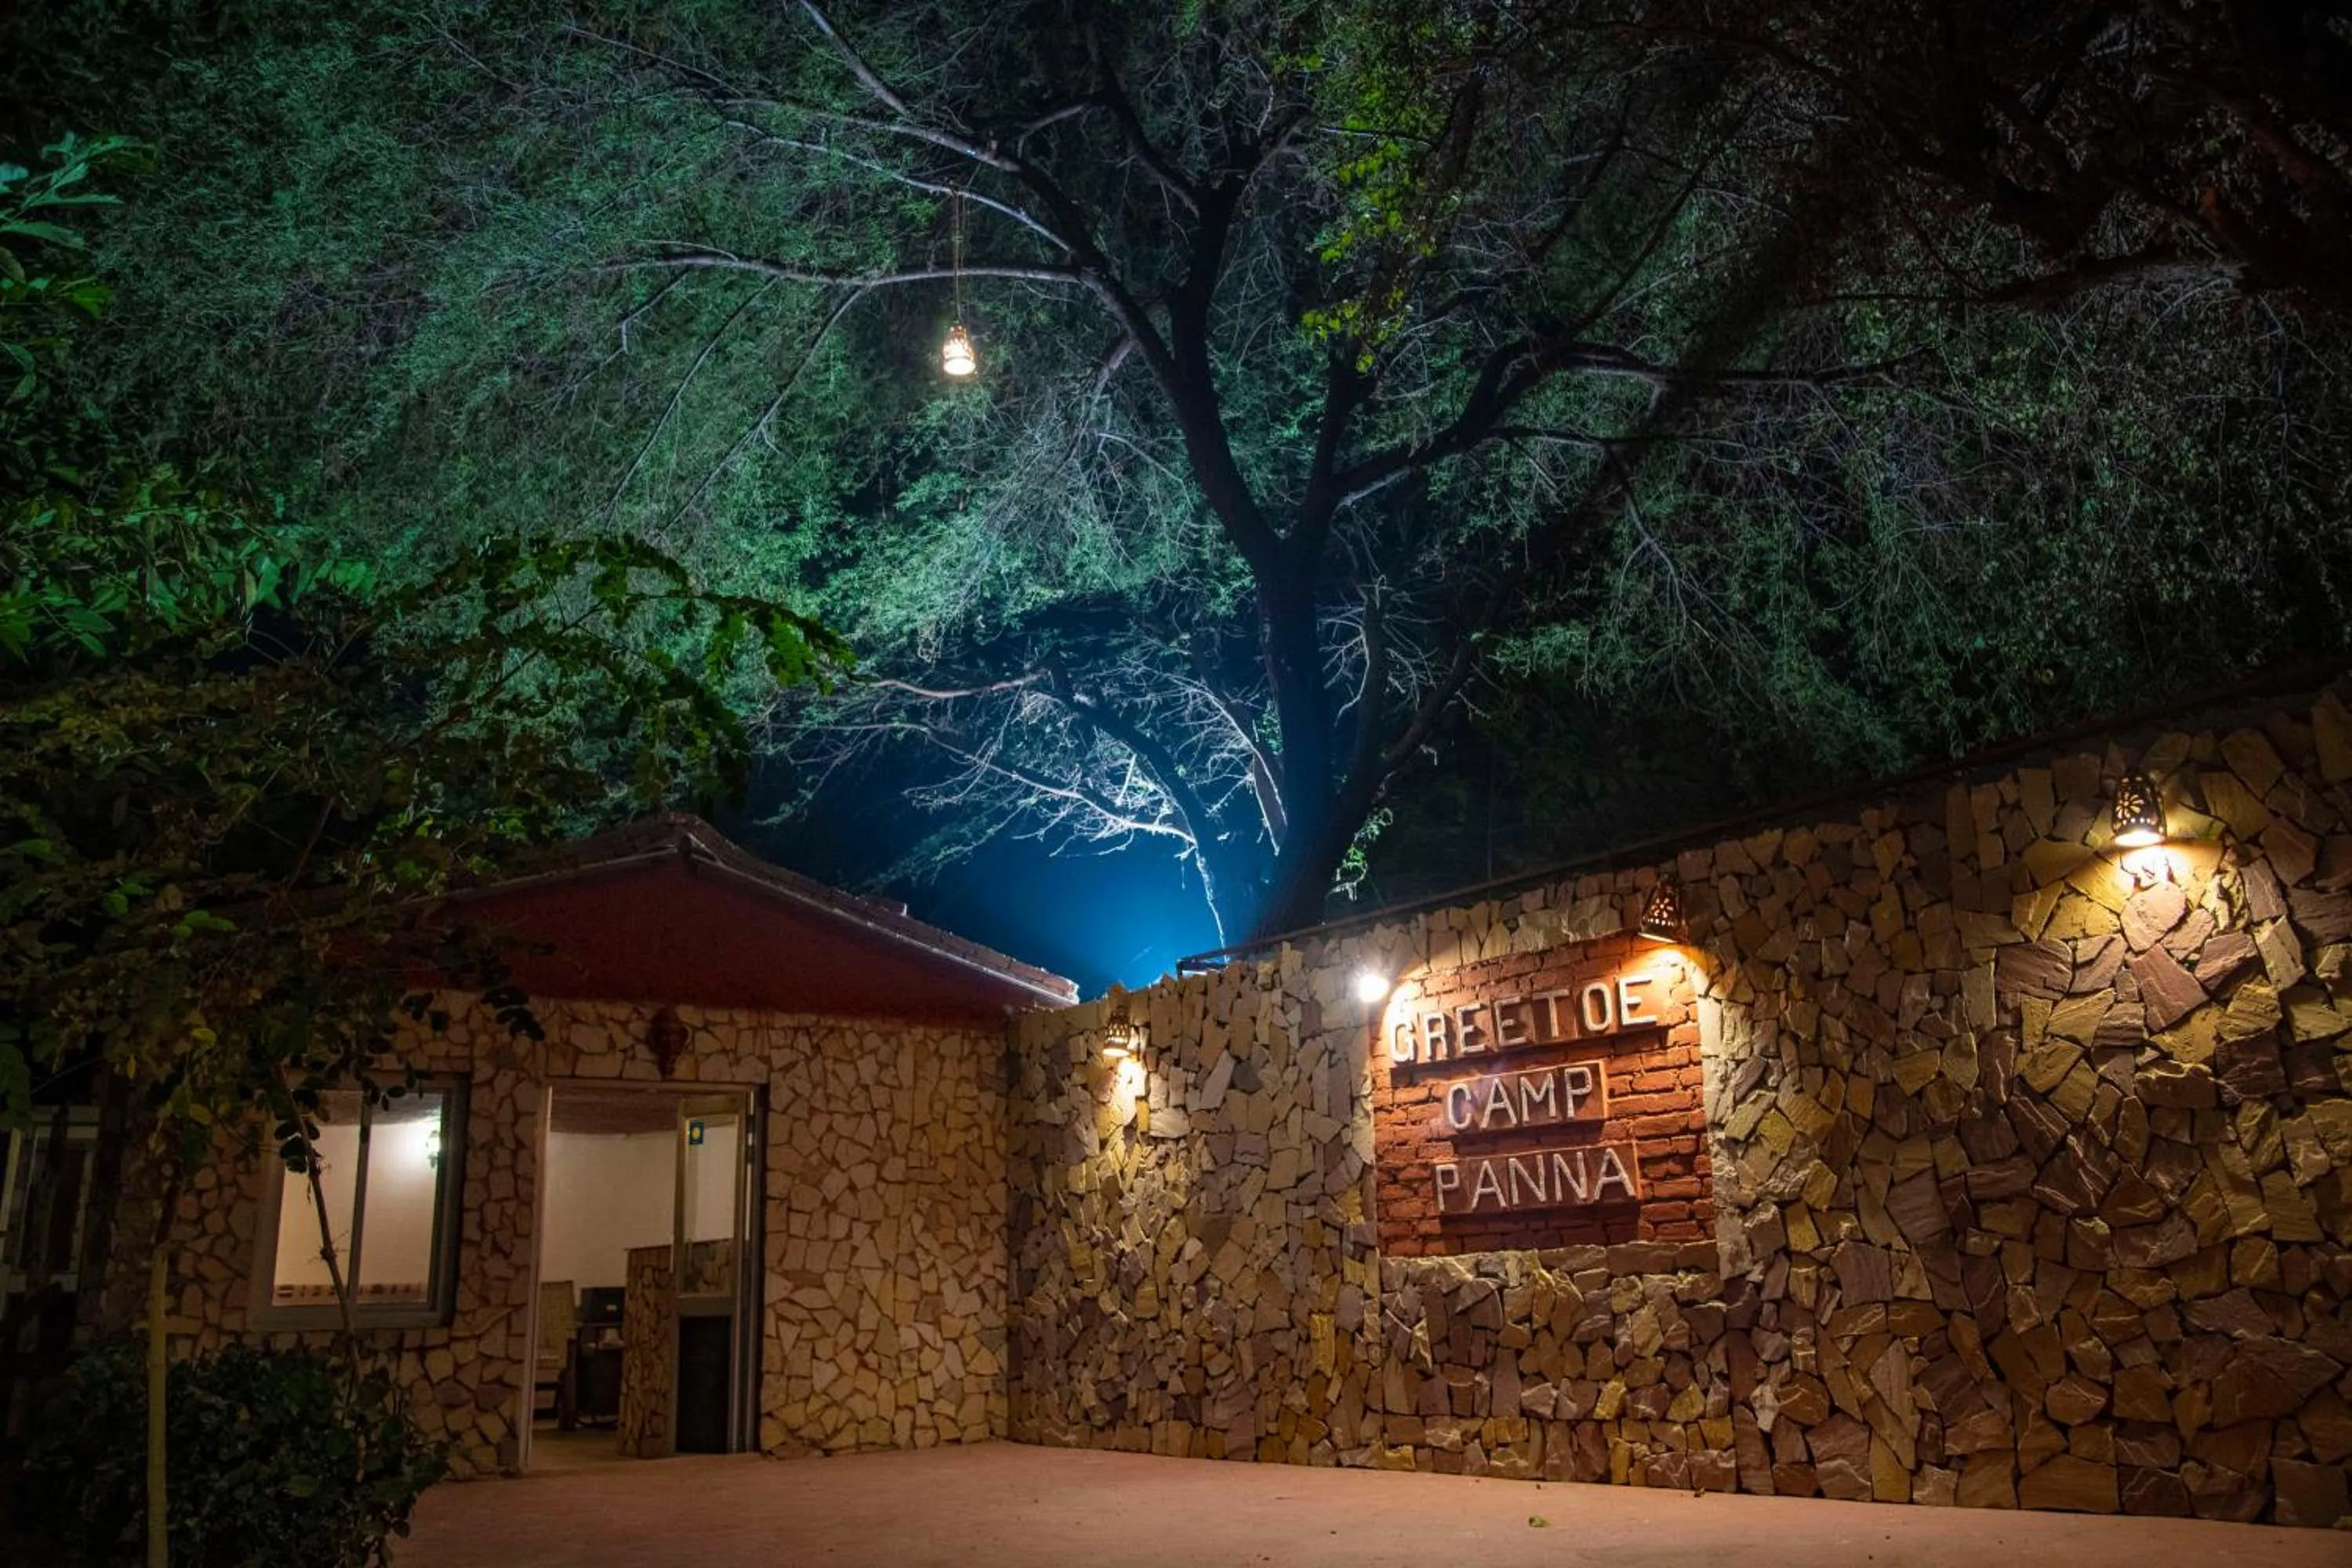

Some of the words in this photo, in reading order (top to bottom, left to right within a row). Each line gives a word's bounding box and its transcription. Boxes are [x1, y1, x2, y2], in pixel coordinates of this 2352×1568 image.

[1390, 975, 1657, 1062] GREETOE
[1447, 1066, 1593, 1130] CAMP
[1435, 1147, 1636, 1212] PANNA
